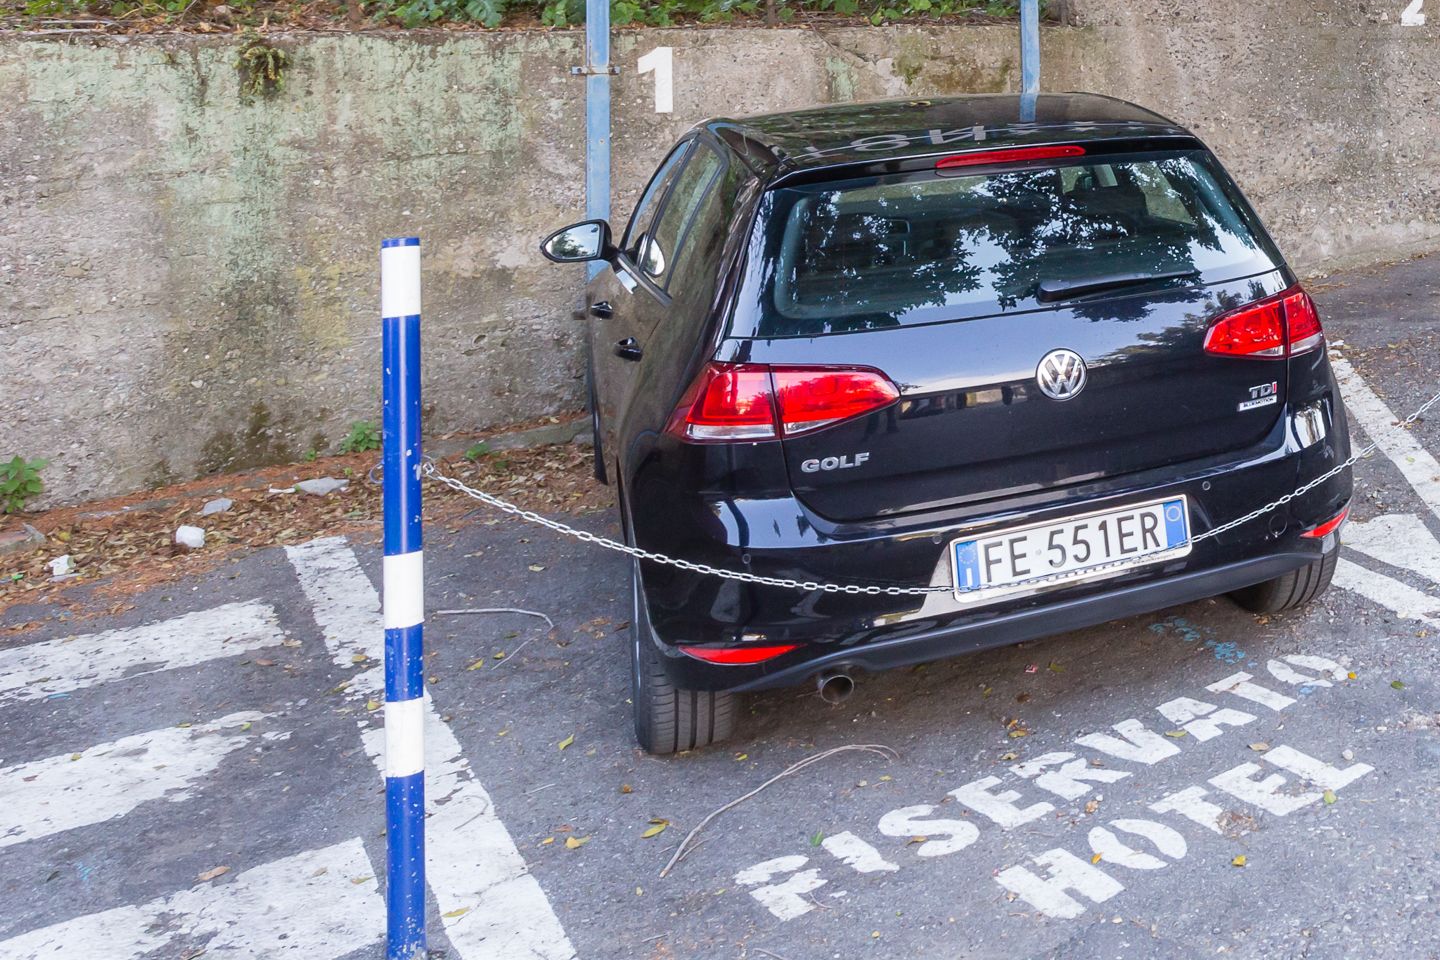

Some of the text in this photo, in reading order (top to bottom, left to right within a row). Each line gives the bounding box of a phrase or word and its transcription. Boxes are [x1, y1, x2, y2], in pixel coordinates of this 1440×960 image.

[637, 46, 673, 113] 1
[1249, 381, 1277, 399] TDI
[801, 452, 869, 473] GOLF
[983, 511, 1162, 583] FE 551ER
[734, 654, 1350, 921] RISERVATO
[994, 745, 1375, 919] HOTEL
